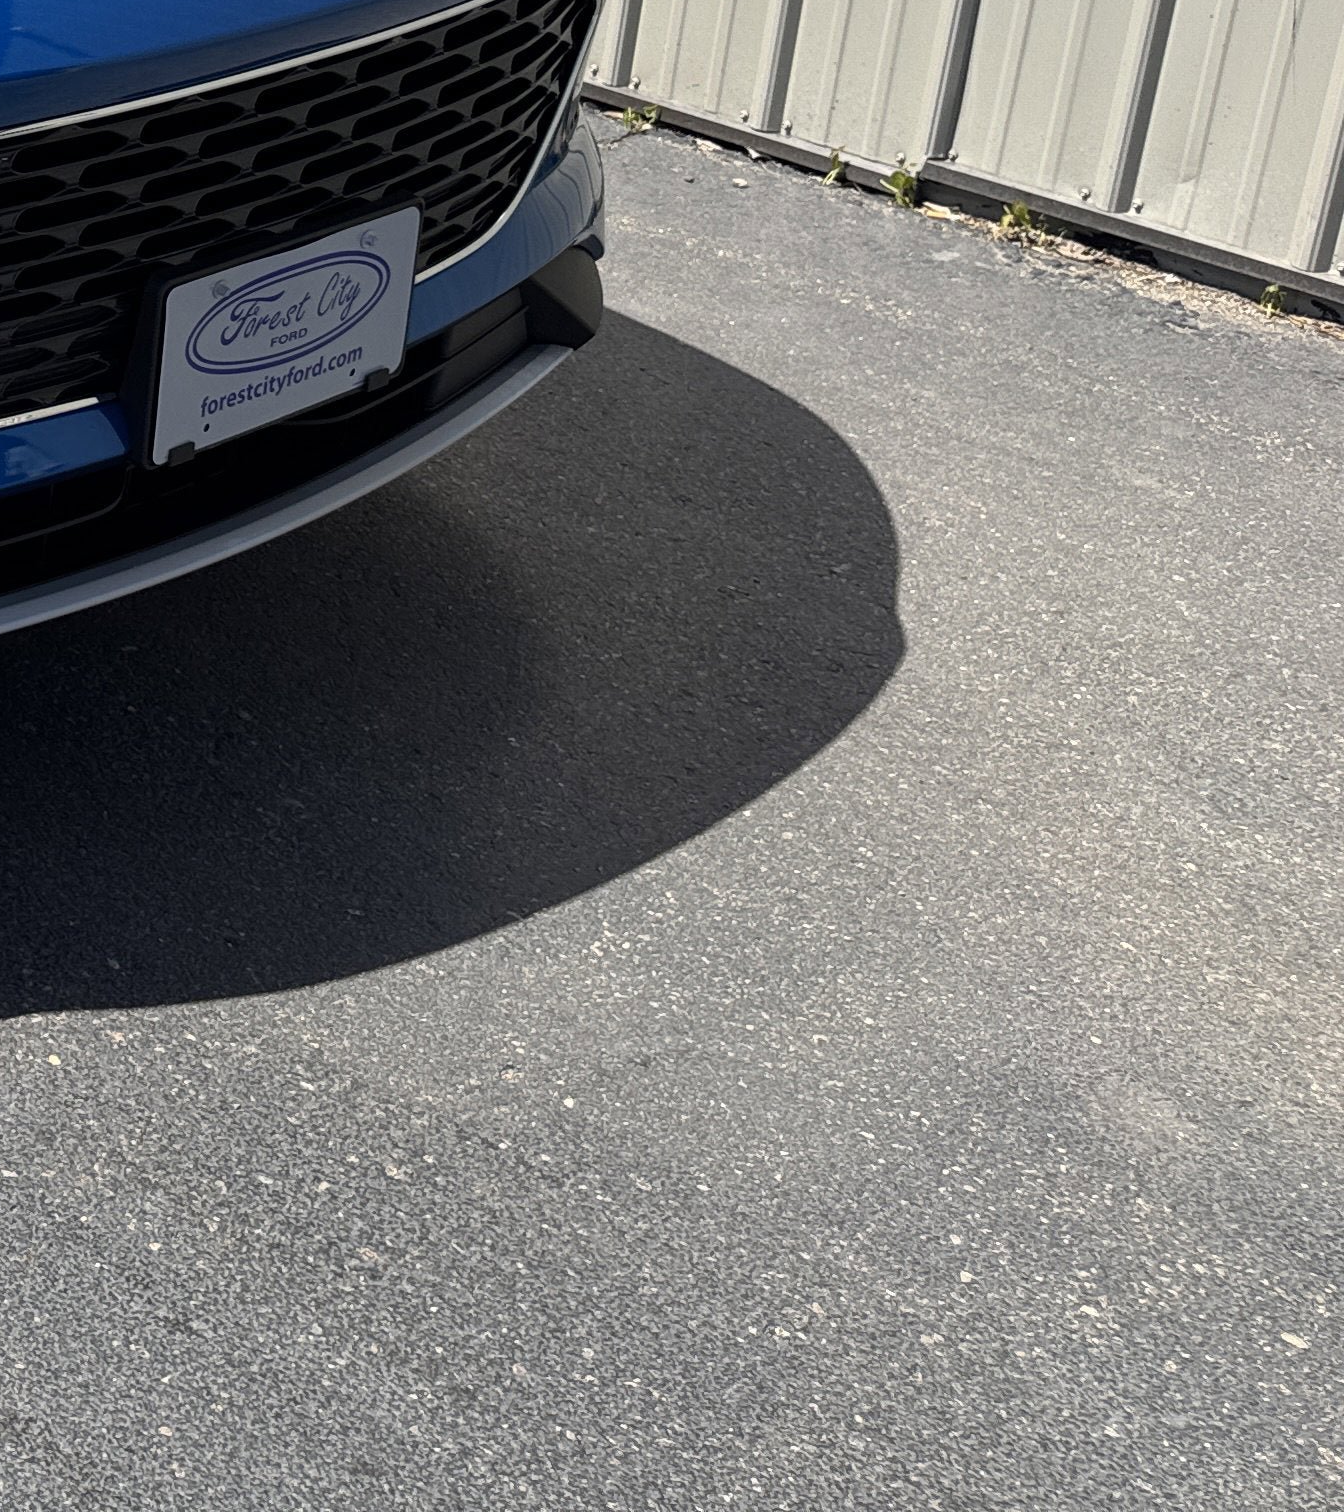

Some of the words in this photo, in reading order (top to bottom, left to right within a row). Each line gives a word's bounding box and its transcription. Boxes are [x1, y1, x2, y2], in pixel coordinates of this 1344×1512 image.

[219, 289, 311, 346] Forest
[316, 271, 362, 322] City
[269, 327, 309, 348] FORD
[199, 345, 364, 419] forestcityford.com
